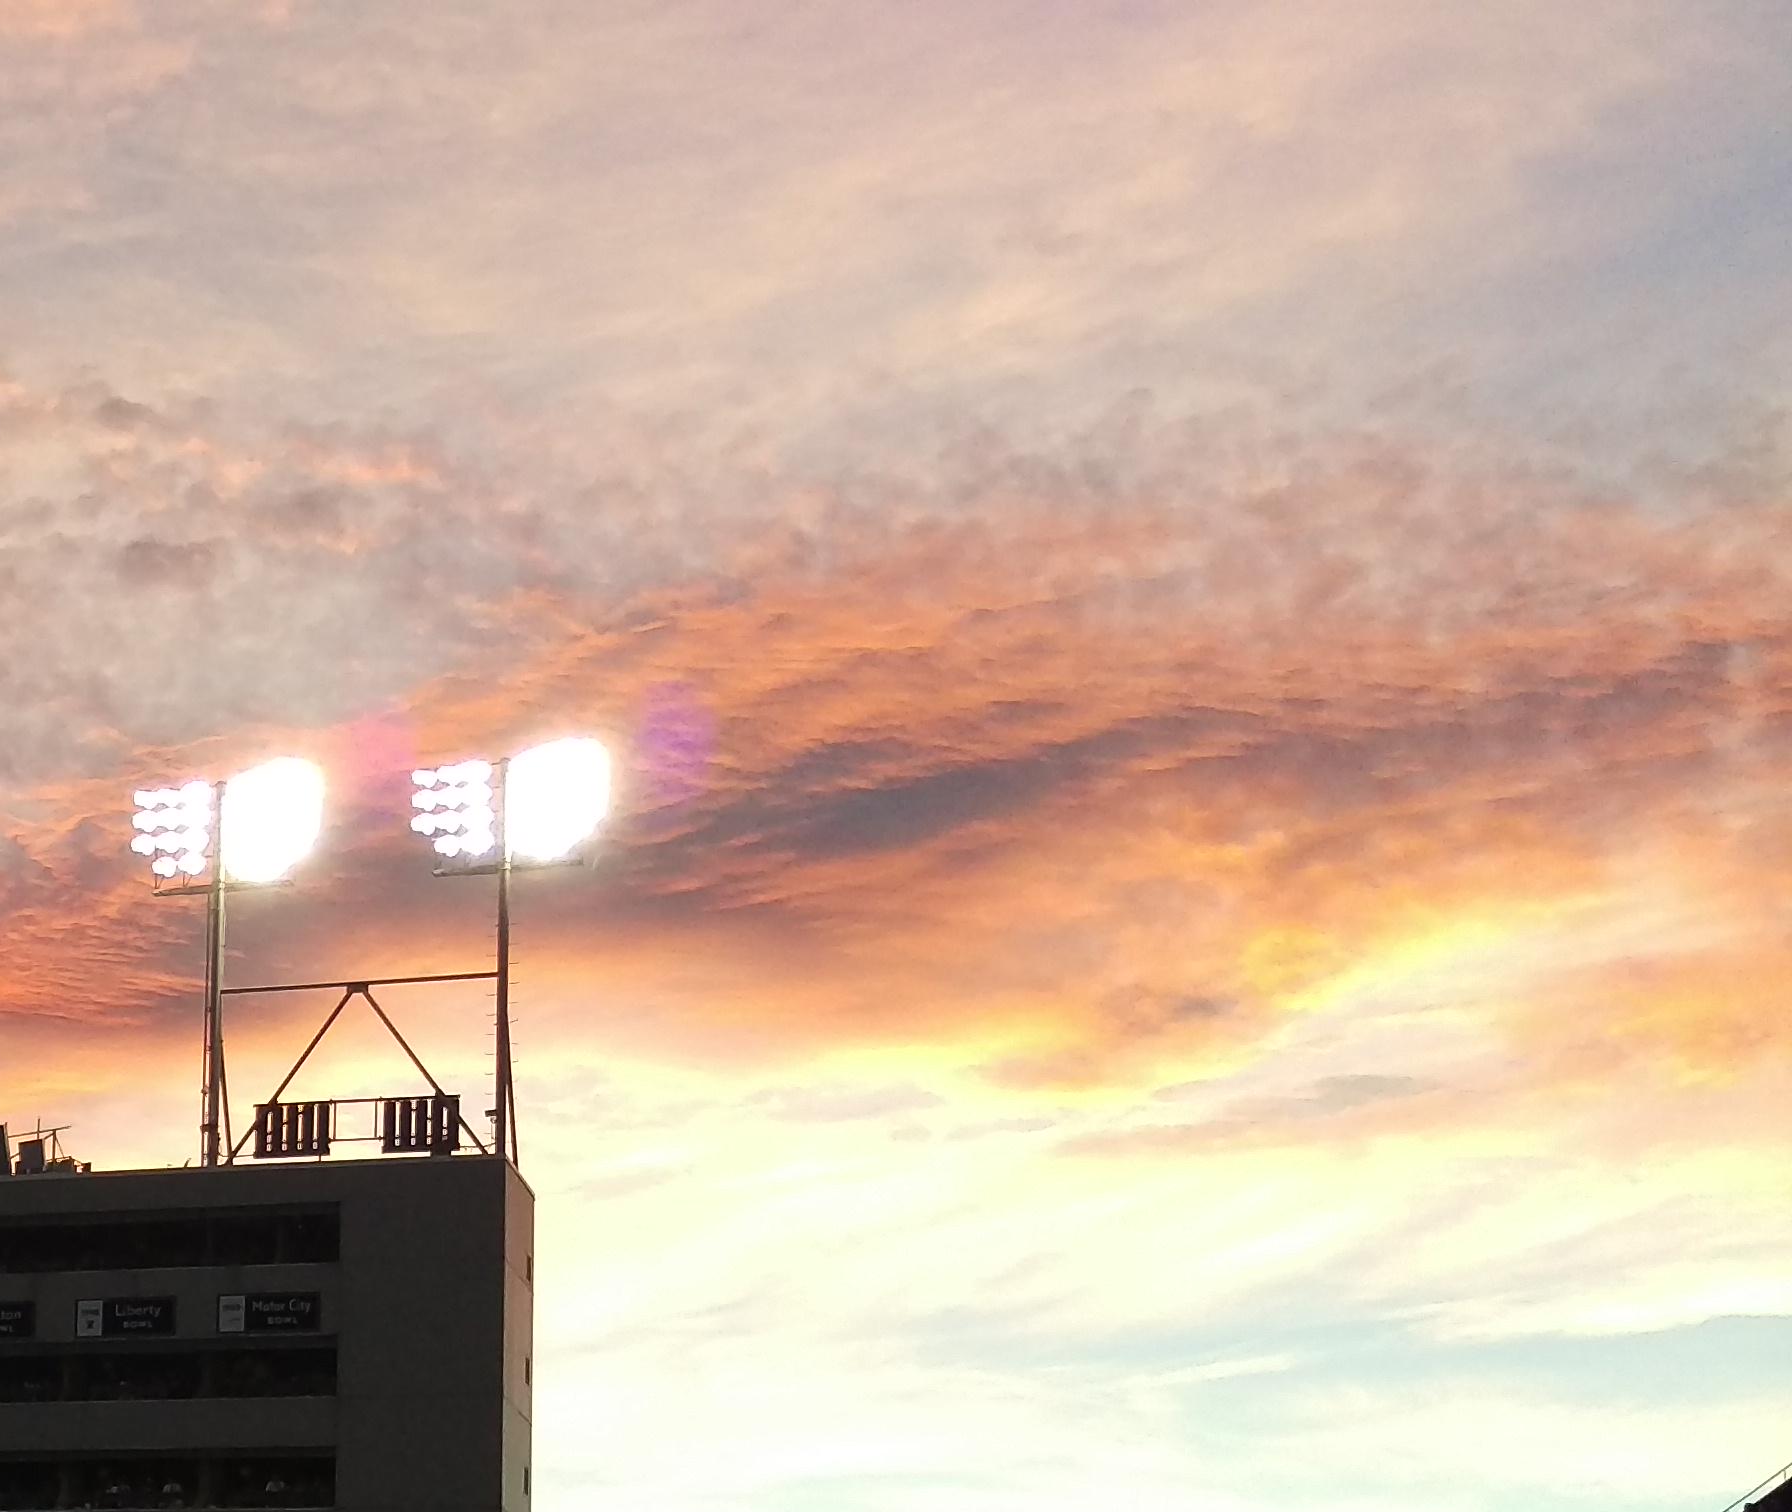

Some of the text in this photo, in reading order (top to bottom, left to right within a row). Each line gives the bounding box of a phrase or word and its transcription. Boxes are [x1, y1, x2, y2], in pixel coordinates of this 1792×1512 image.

[115, 1304, 161, 1318] Liberty
[252, 1301, 285, 1311] Motor
[289, 1299, 311, 1313] City
[123, 1320, 152, 1329] BOWL
[266, 1316, 298, 1325] BOWL
